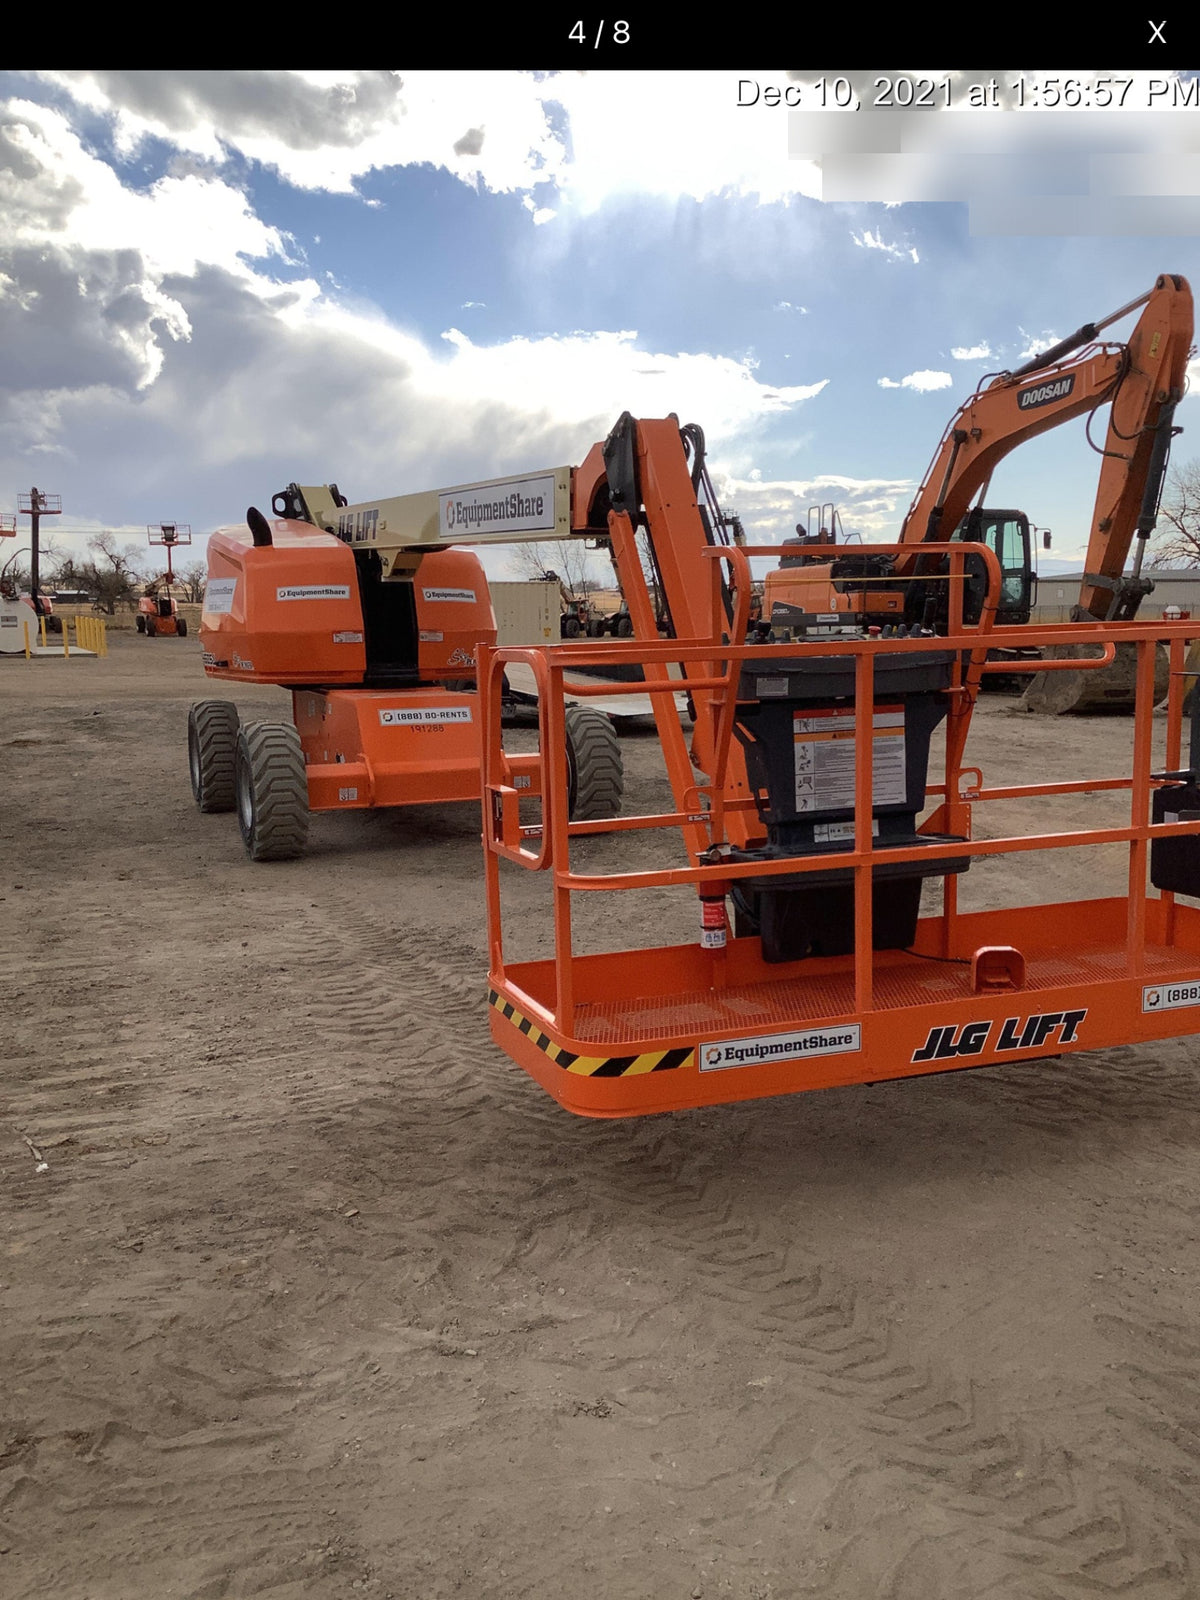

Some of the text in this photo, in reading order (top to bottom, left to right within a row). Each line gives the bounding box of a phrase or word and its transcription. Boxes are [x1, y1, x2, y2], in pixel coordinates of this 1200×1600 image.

[1021, 379, 1072, 407] DOOSAN
[456, 493, 544, 529] EquipmentShare
[355, 509, 379, 542] LIFT
[286, 588, 346, 597] EquipmentShare
[431, 591, 474, 600] EquipmentShare
[397, 712, 422, 721] (888)
[724, 1033, 853, 1062] EquipmentShare
[910, 1008, 1089, 1063] JLG LIFT
